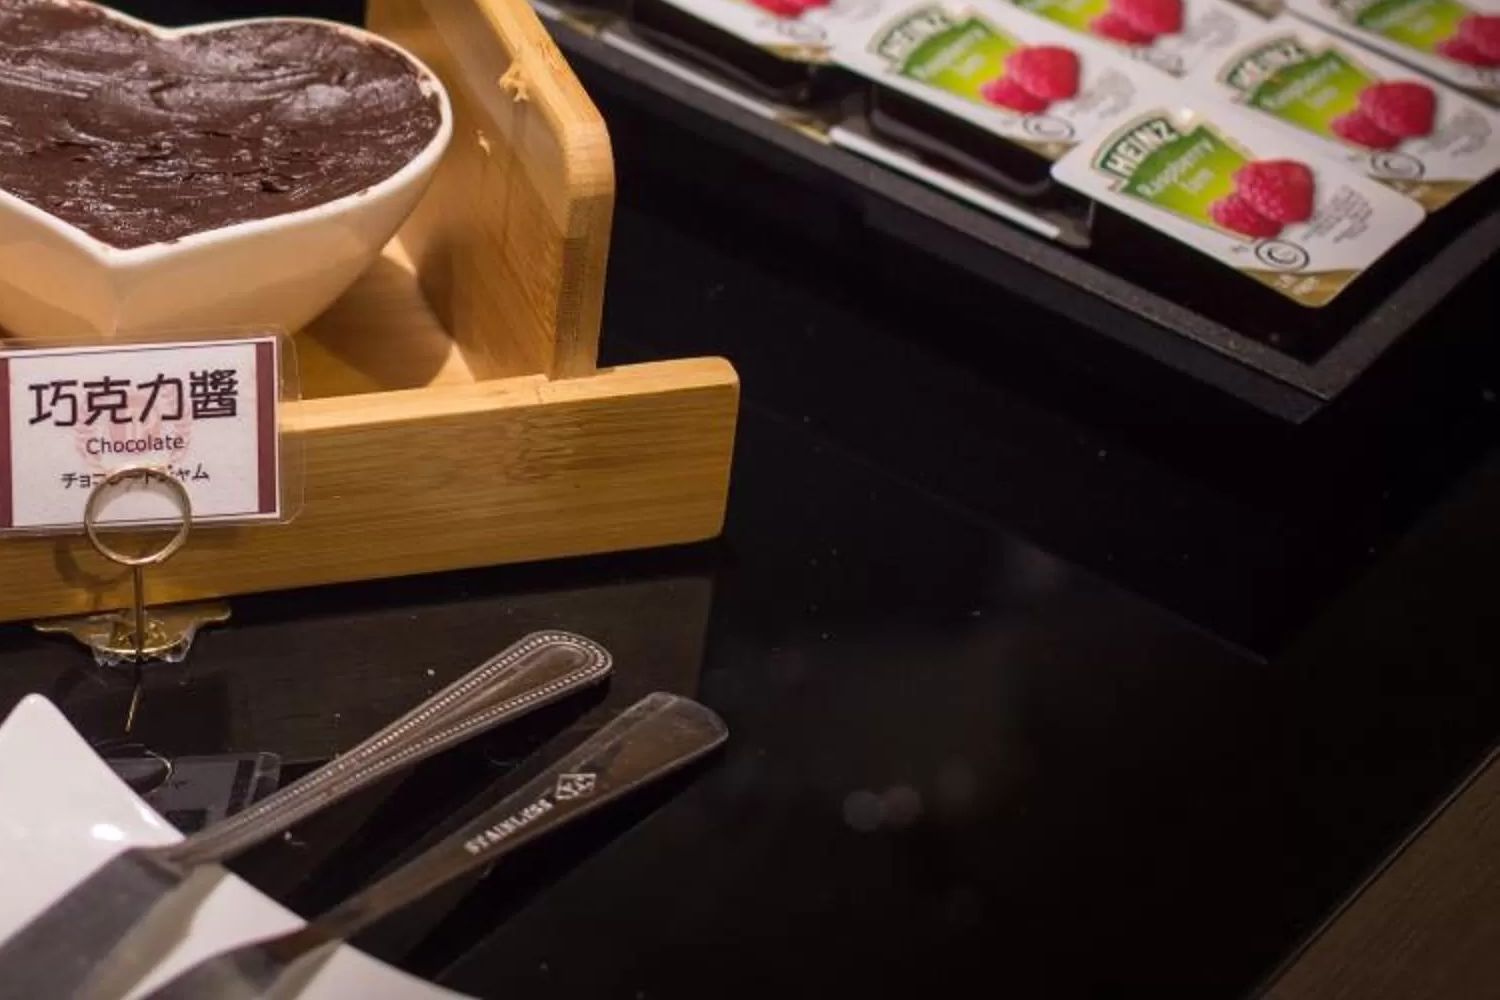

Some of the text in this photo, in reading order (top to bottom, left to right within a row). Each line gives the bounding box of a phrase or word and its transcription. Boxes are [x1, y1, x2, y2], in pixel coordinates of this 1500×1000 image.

[1105, 119, 1180, 177] HEINZ
[28, 369, 239, 427] 巧克力醬
[85, 434, 185, 455] Chocolate
